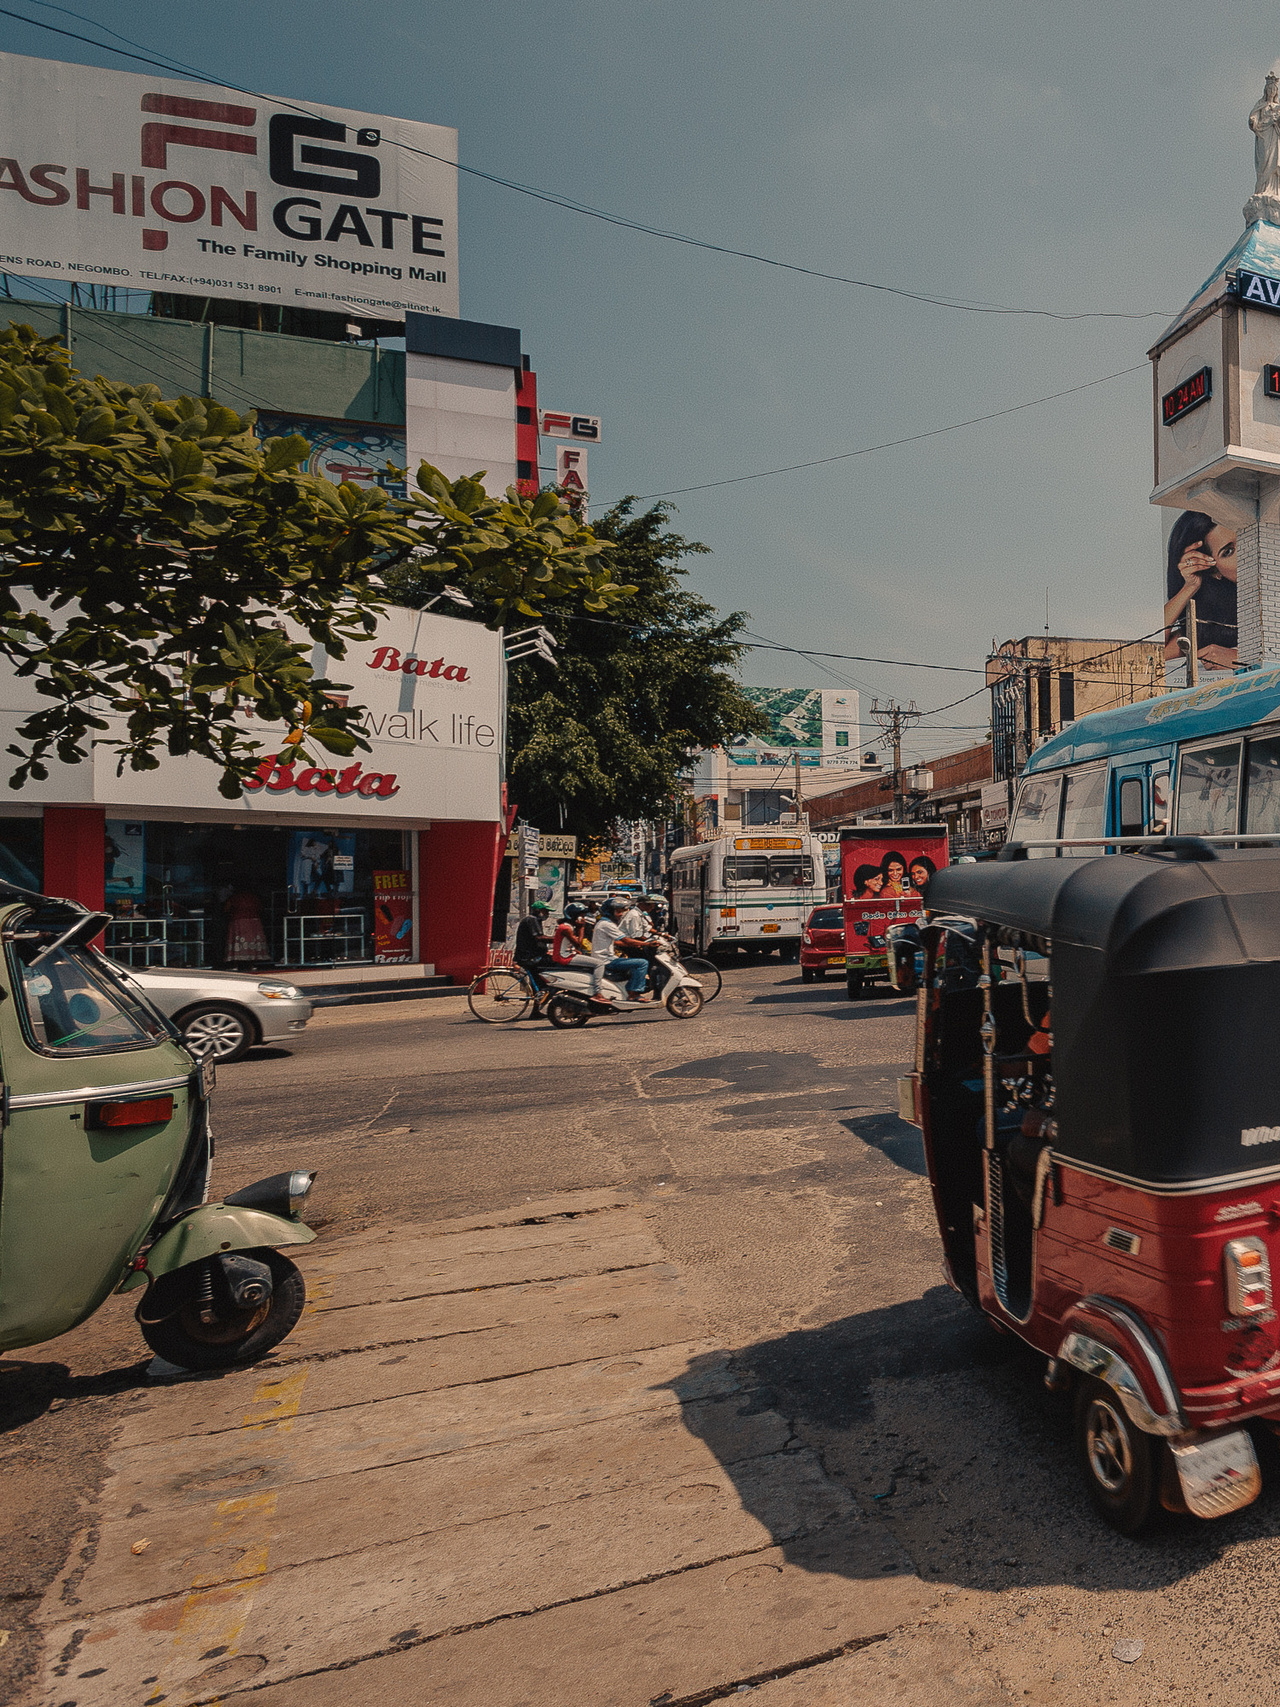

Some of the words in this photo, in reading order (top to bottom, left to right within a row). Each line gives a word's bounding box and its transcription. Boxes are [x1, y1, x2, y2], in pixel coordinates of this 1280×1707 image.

[272, 196, 446, 258] GATE
[26, 257, 65, 271] ROAD,
[68, 261, 133, 278] NEGOMBO.
[237, 280, 255, 291] 531
[257, 283, 283, 294] 8901
[197, 238, 236, 256] The
[243, 243, 309, 267] Family
[314, 253, 403, 280] Shopping
[408, 265, 447, 284] Mall
[543, 412, 599, 439] FG
[366, 646, 471, 682] Bata
[419, 679, 445, 690] meets
[362, 708, 440, 743] walk
[451, 713, 495, 747] life
[242, 754, 400, 797] Bata
[374, 873, 407, 889] FREE
